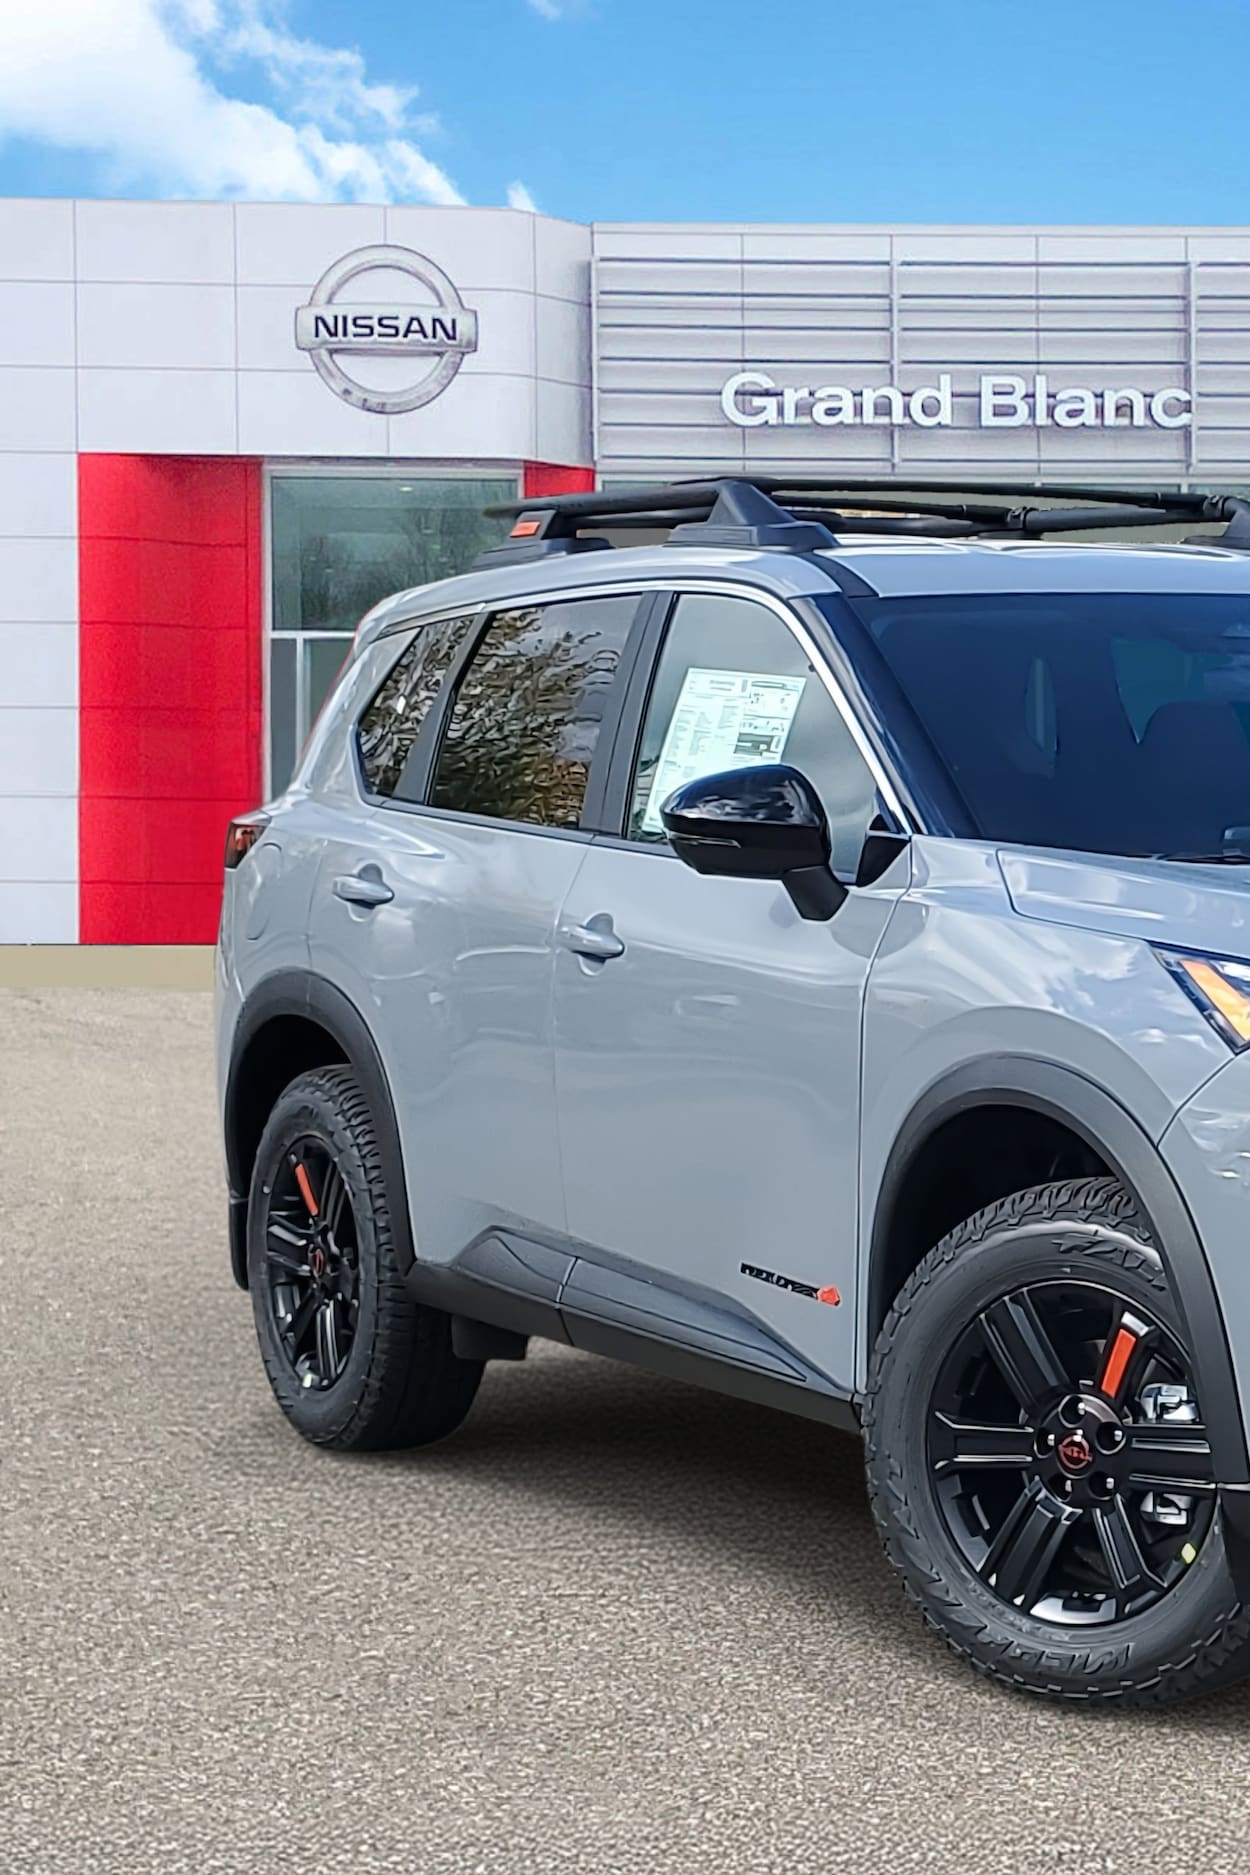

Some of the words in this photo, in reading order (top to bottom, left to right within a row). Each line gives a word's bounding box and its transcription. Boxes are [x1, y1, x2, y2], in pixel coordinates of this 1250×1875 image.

[313, 314, 458, 342] NISSAN
[720, 371, 952, 427] Grand
[979, 373, 1193, 428] Blanc
